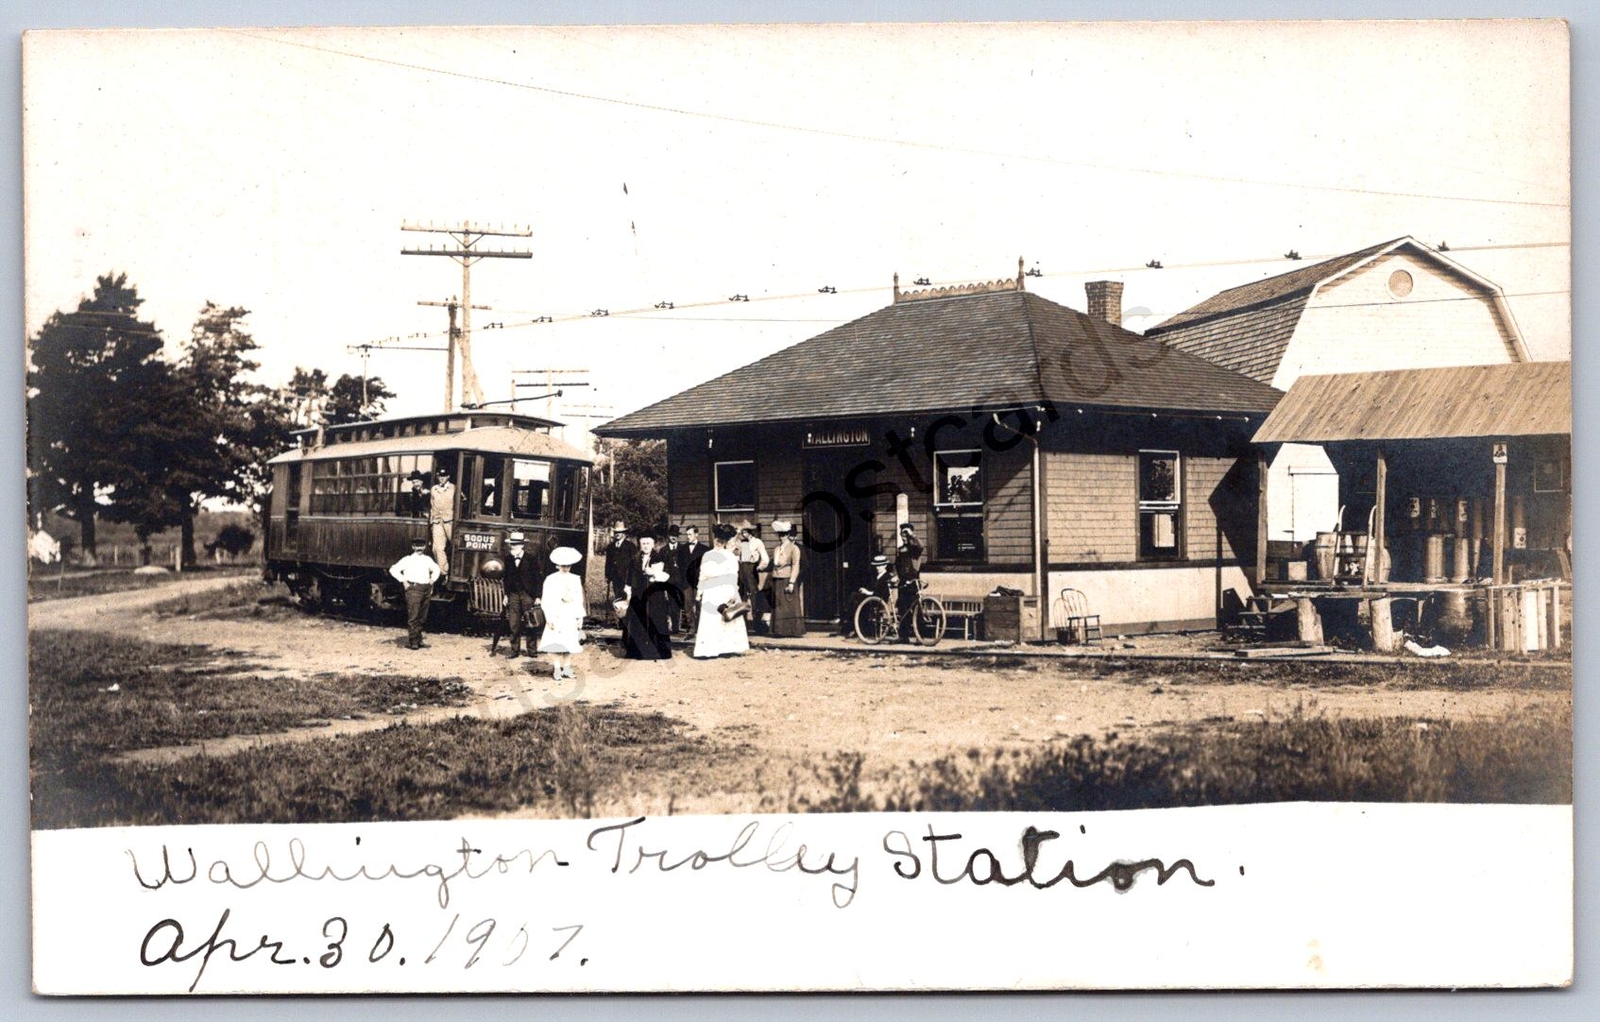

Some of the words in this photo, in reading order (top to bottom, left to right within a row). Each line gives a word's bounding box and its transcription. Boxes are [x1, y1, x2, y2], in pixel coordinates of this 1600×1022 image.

[464, 534, 495, 543] SODUS
[465, 541, 493, 550] POINT
[127, 837, 569, 909] Wallington
[585, 816, 858, 908] Trolley
